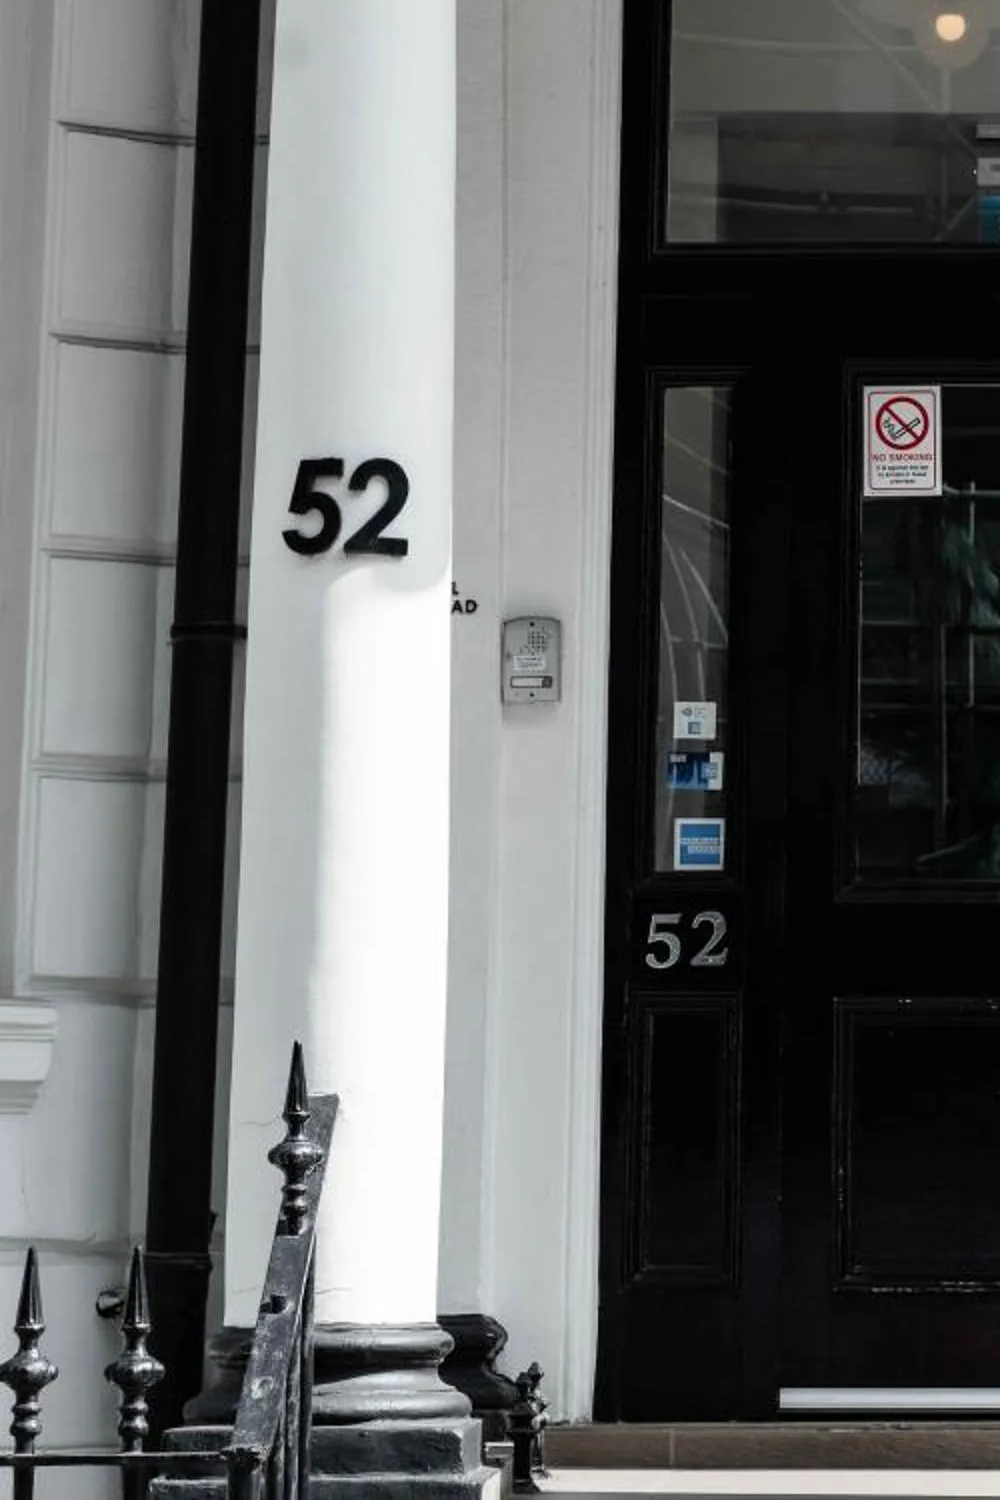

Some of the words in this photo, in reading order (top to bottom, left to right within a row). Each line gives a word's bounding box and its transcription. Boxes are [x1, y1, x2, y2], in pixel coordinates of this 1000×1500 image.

[872, 452, 887, 462] NO
[888, 452, 933, 462] SMOKING
[282, 457, 410, 557] 52
[645, 911, 729, 969] 52
